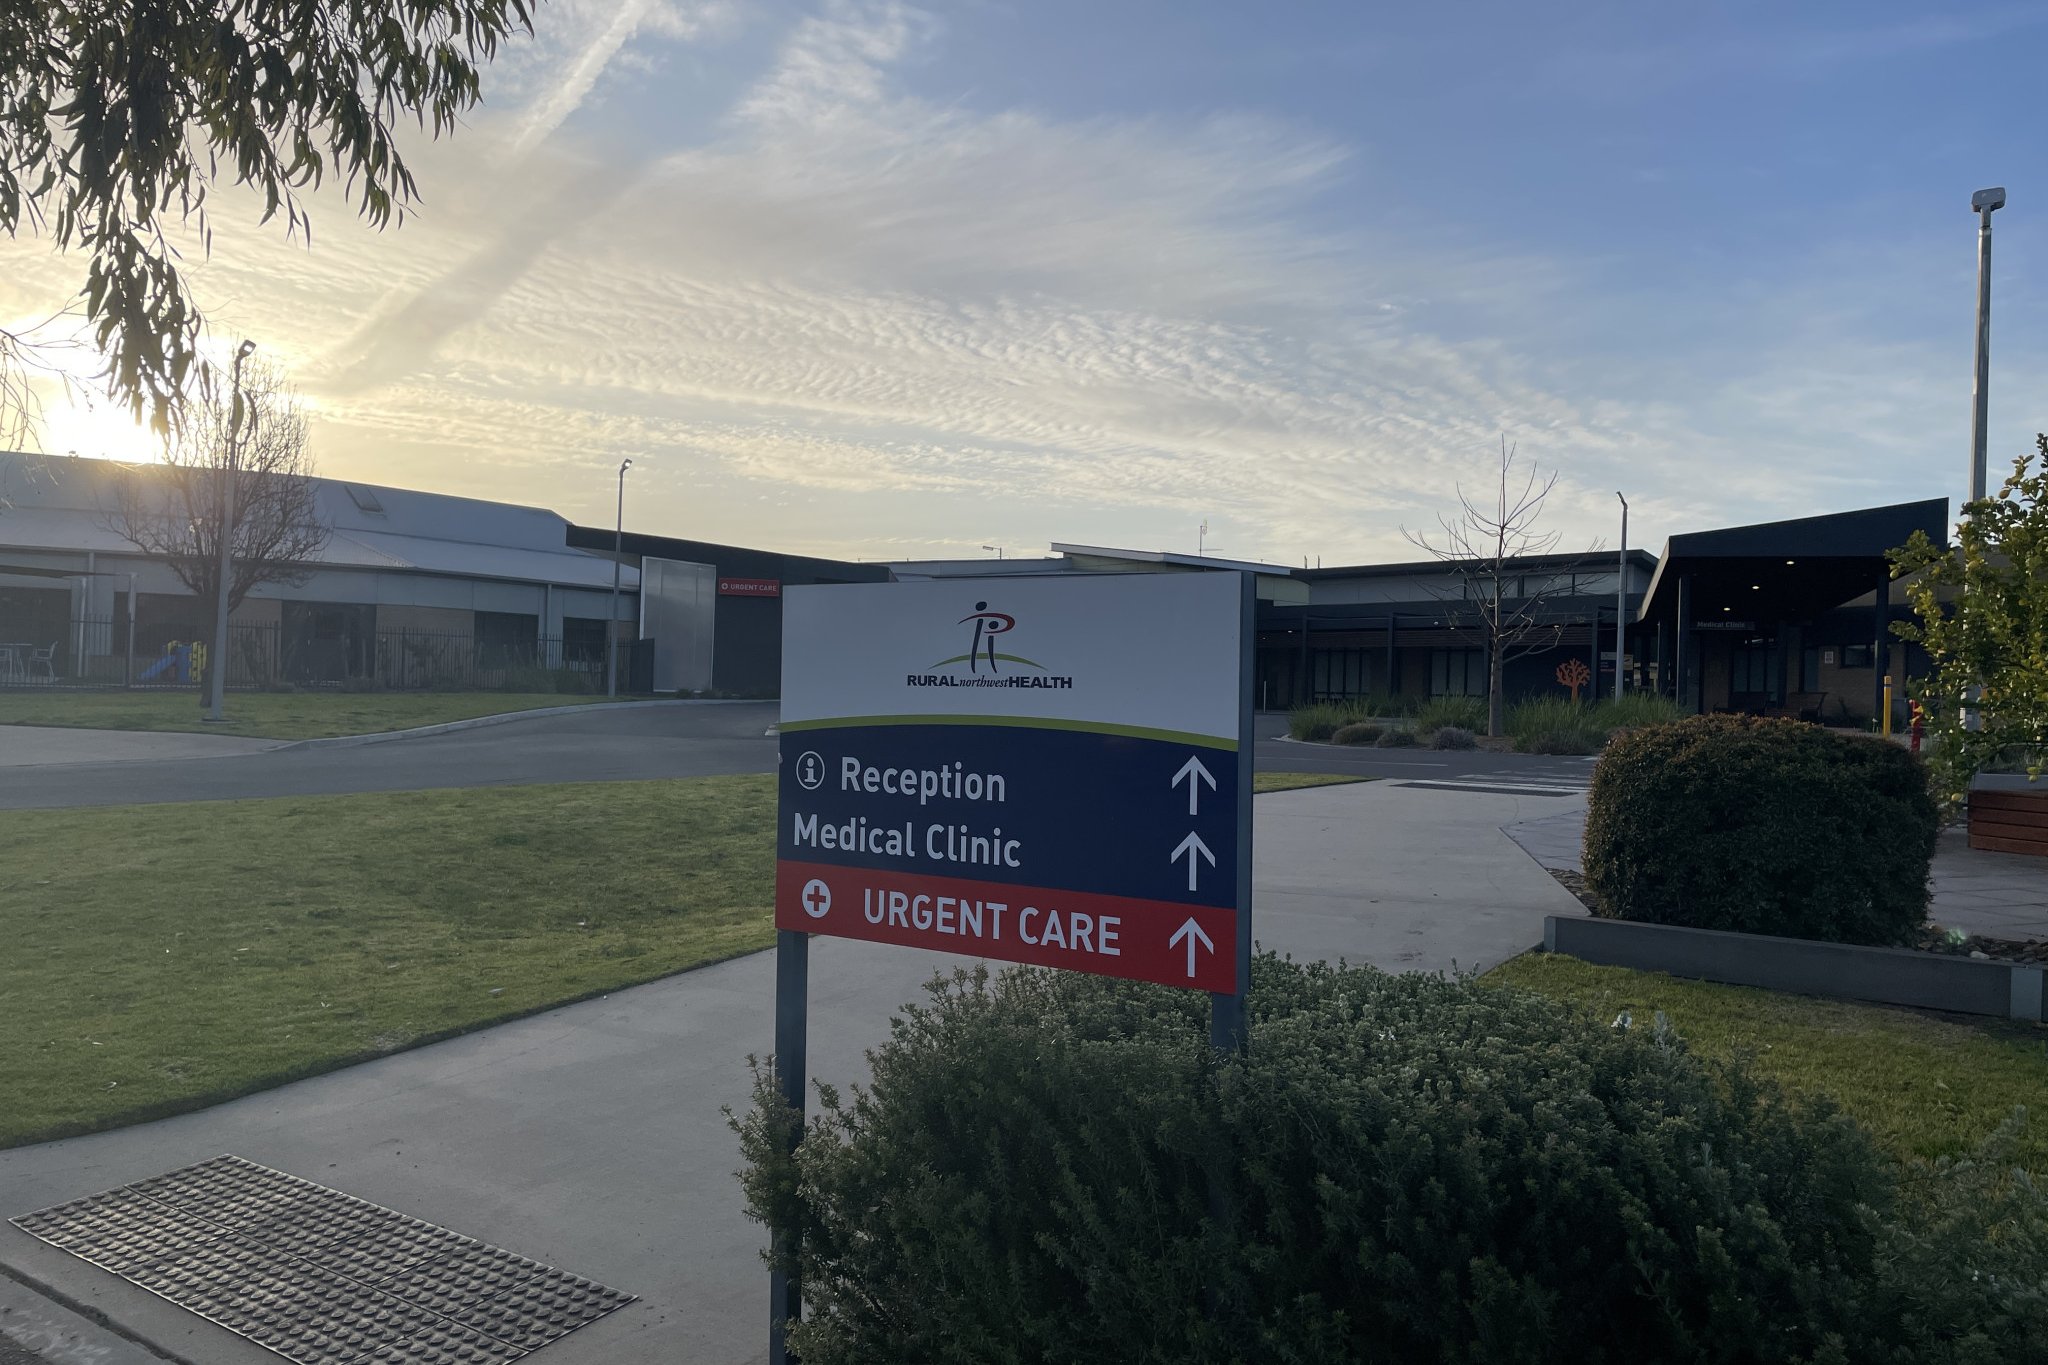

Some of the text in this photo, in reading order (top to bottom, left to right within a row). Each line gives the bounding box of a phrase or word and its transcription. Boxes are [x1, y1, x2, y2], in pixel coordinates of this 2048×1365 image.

[759, 584, 777, 592] CARE
[841, 756, 1005, 805] Reception
[793, 812, 1021, 868] Medical Clinic
[864, 888, 1121, 956] URGENT CARE
